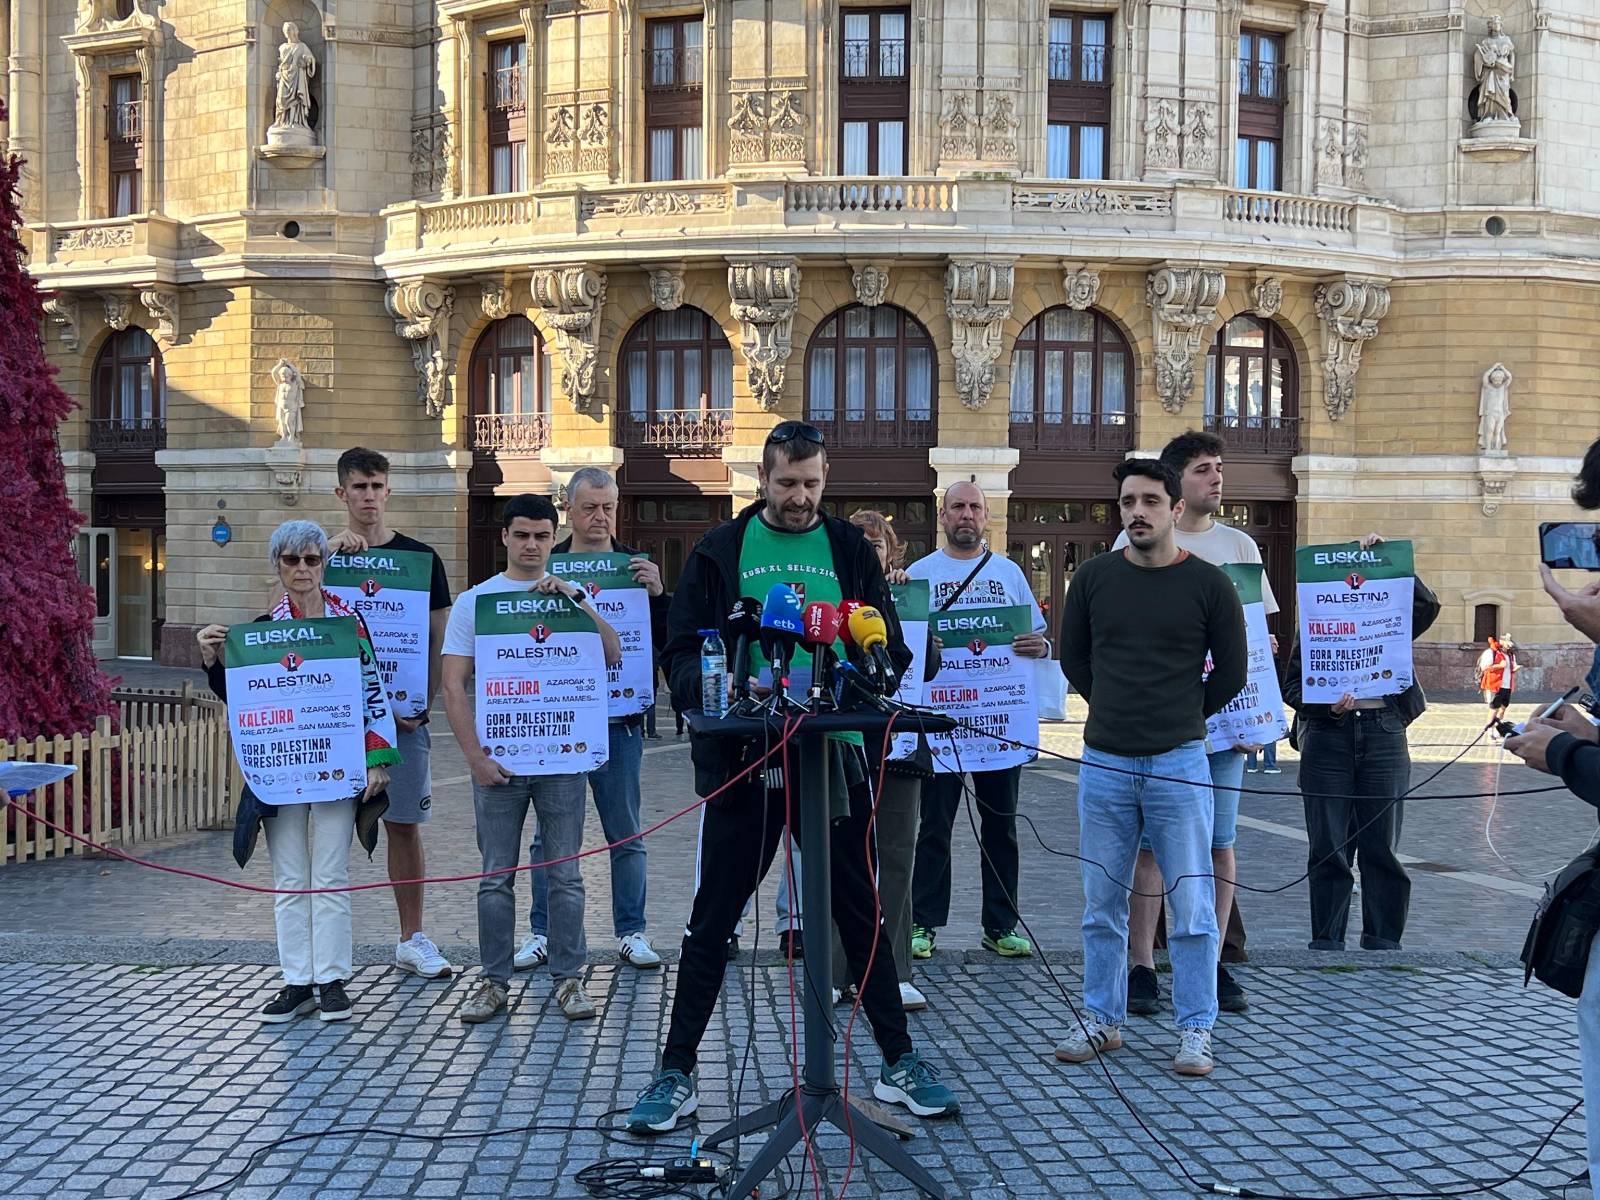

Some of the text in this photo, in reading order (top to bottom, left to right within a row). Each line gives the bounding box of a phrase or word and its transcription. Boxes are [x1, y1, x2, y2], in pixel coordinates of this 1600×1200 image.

[330, 555, 401, 571] EUSKAL
[1314, 550, 1382, 565] EUSKAL
[552, 559, 618, 575] EUSKAL
[742, 564, 782, 579] EUSKAL
[1316, 591, 1389, 604] PALESTINA
[496, 598, 570, 615] EUSKAL
[773, 618, 795, 630] etb
[937, 615, 1004, 631] EUSKAL
[1308, 621, 1356, 635] KALEJIRA
[244, 627, 322, 646] EUSKAL
[497, 646, 577, 660] PALESTINA
[1309, 644, 1384, 660] GORA PALESTINAR
[939, 656, 1010, 671] PALESTINA
[1310, 656, 1380, 672] ERRESISTENTZIA!
[247, 672, 332, 691] PALESTINA
[486, 679, 540, 697] KALEJIRA
[546, 678, 585, 686] AZAROAK
[575, 684, 596, 692] 18:30
[983, 684, 1017, 693] AZAROAK
[930, 688, 978, 703] KALEJIRA
[300, 704, 340, 714] AZAROAK
[981, 700, 996, 708] SAN
[238, 708, 294, 728] KALEJIRA
[330, 711, 351, 719] 18:30
[486, 710, 576, 726] GORA PALESTINAR
[297, 723, 316, 731] SAN
[486, 723, 571, 740] ERRESISTENTZIA!
[241, 737, 332, 756] GORA PALESTINAR
[243, 751, 328, 769] ERRESISTENTZIA!
